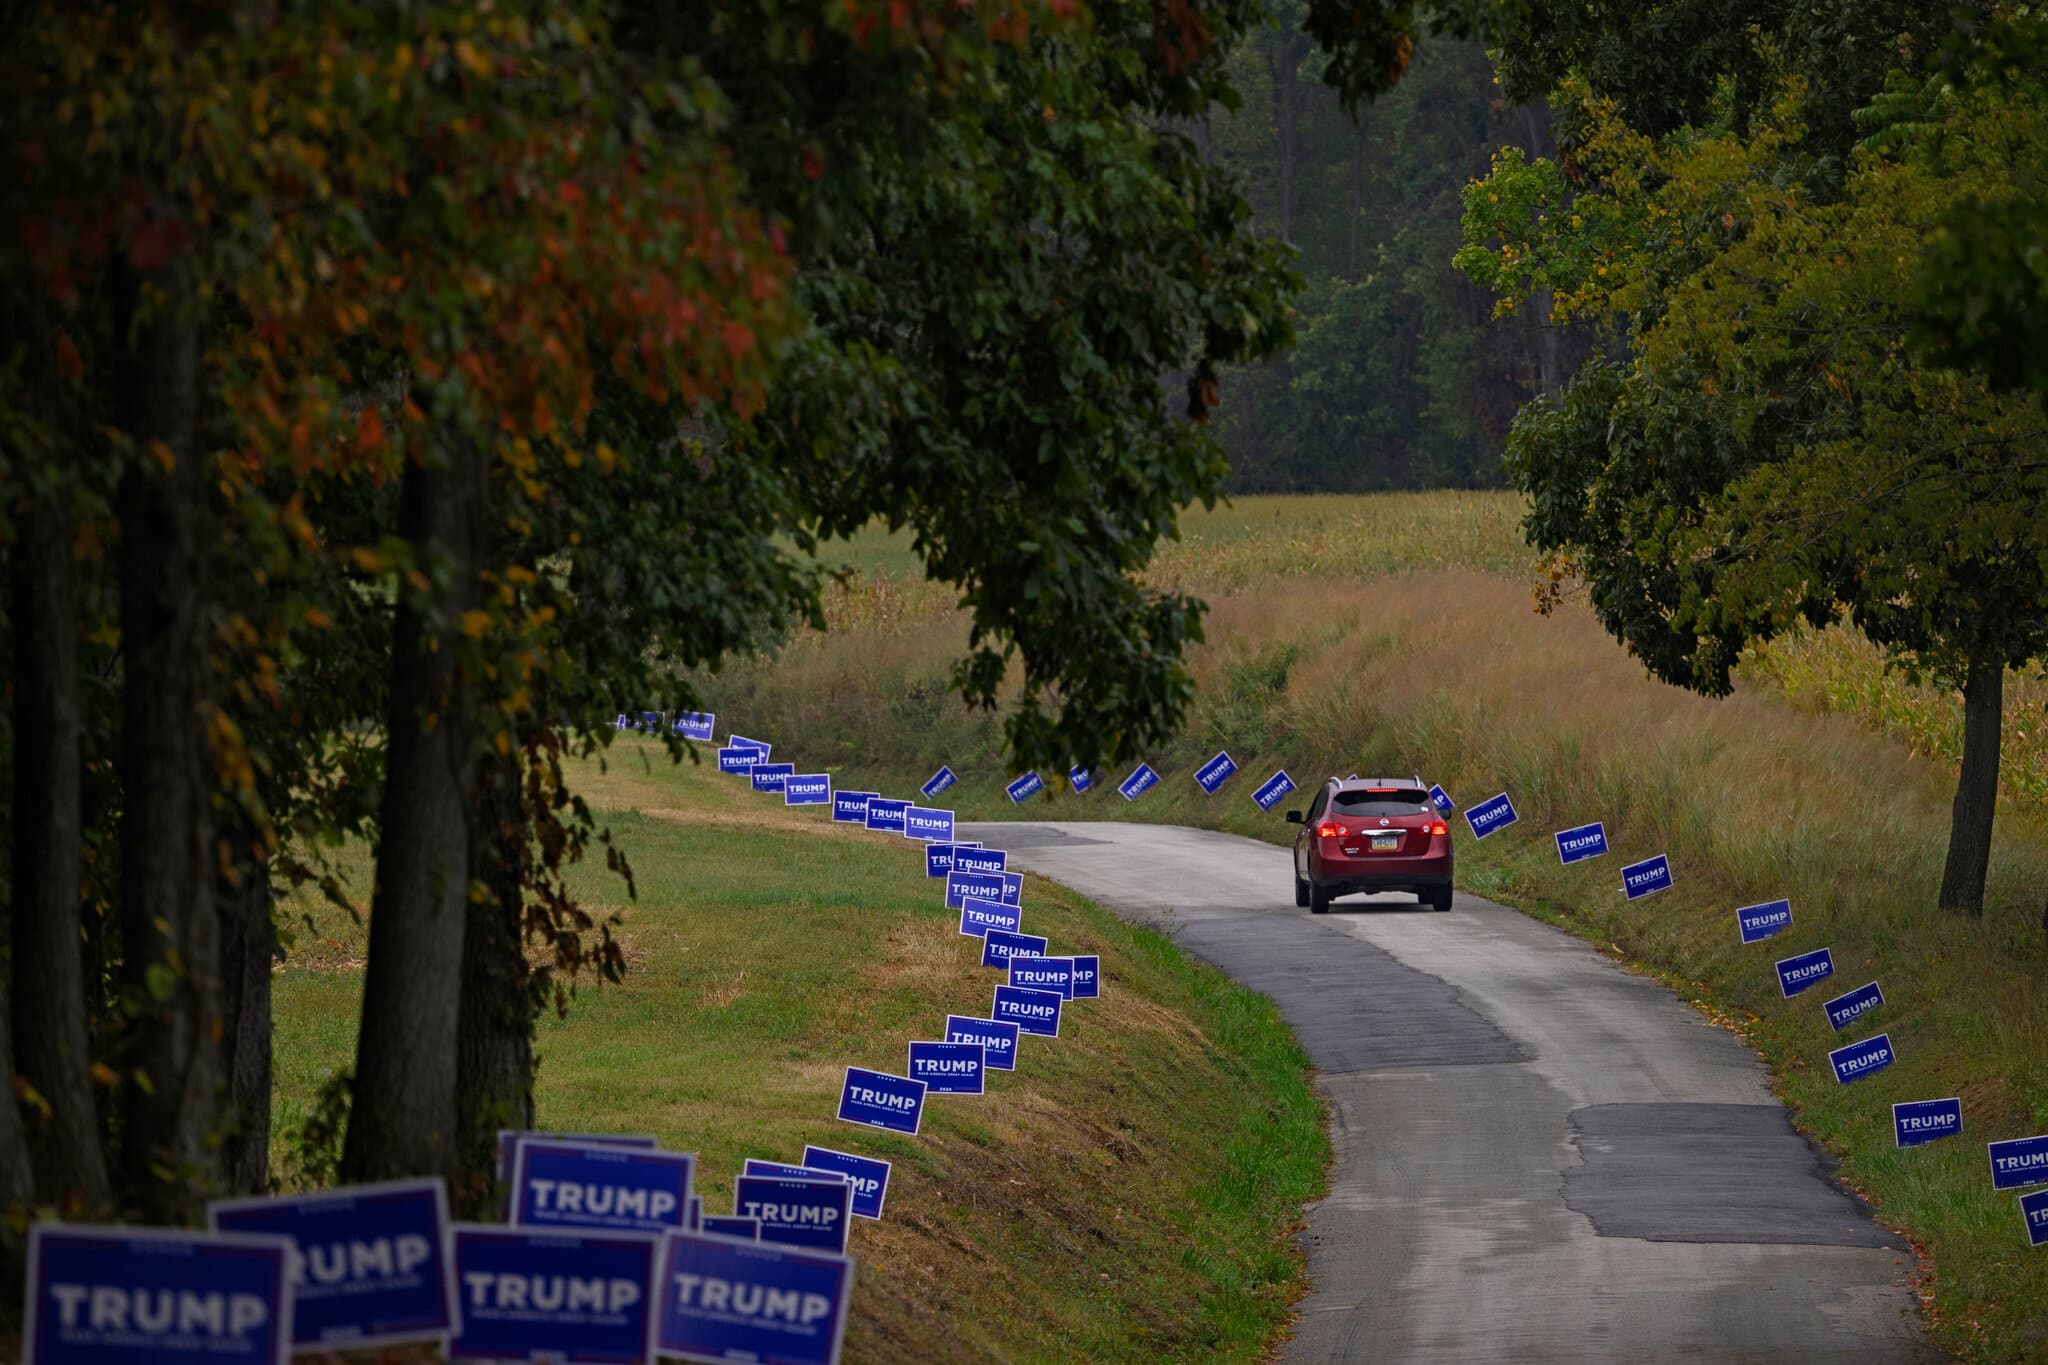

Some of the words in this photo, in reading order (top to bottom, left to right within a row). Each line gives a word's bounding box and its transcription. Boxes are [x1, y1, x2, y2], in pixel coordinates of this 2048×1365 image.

[722, 756, 758, 765] TRUMP
[1071, 768, 1088, 783] TRU
[1201, 760, 1230, 785] TRUMP
[788, 784, 826, 793] TRUMP
[928, 773, 951, 796] TRUMP
[1012, 776, 1039, 798] TRUMP
[1126, 770, 1152, 797] TRUMP
[1260, 779, 1288, 805] TRUMP
[837, 801, 868, 810] TRUM
[871, 808, 905, 818] TRUM
[909, 817, 950, 829] TRUMP
[1472, 804, 1509, 826] TRUMP
[1562, 834, 1602, 851] TRUMP
[958, 858, 1002, 870] TRUMP
[1627, 866, 1666, 886] TRUMP
[952, 884, 1000, 897] TRUMP
[968, 910, 1016, 926] TRUMP
[1744, 912, 1788, 928] TRUMP
[990, 943, 1040, 958] TRUMP
[1014, 970, 1069, 983] TRUMP
[1783, 961, 1829, 982] TRUMP
[1000, 1000, 1055, 1018] TRUMP
[1832, 996, 1879, 1022] TRUMP
[952, 1032, 1012, 1050] TRUMP
[915, 1058, 978, 1073] TRUMP
[1838, 1048, 1888, 1073] TRUMP
[850, 1086, 916, 1110] TRUMP
[1900, 1113, 1956, 1130] TRUMP
[529, 1178, 678, 1220] TRUMP
[744, 1201, 840, 1226] TRUMP
[462, 1272, 642, 1313] TRUMP
[672, 1272, 832, 1326] TRUMP
[48, 1282, 270, 1336] TRUMP
